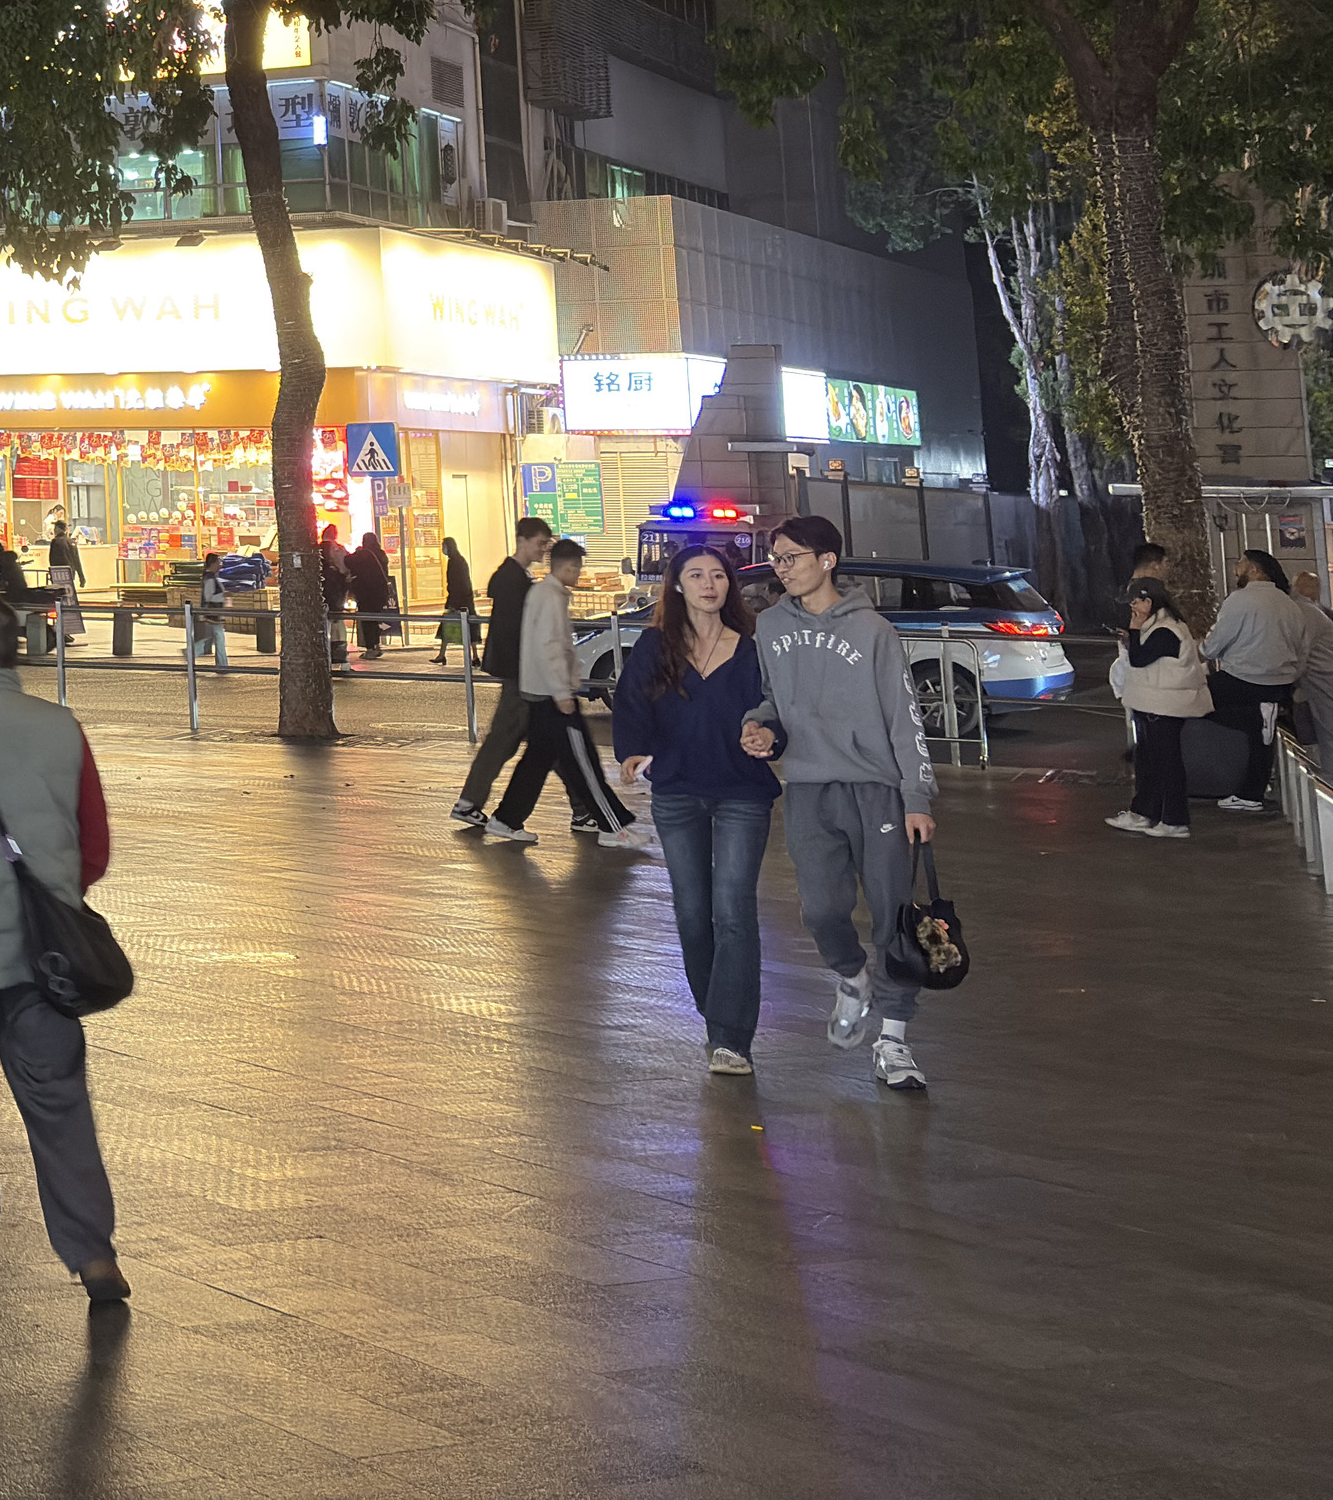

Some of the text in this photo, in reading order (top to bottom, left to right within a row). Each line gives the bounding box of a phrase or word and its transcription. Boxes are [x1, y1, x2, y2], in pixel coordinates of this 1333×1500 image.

[109, 293, 222, 323] WAH
[429, 292, 478, 327] WING
[593, 371, 654, 393] 铭厨
[531, 465, 553, 492] P
[772, 629, 863, 666] SPITFIRE
